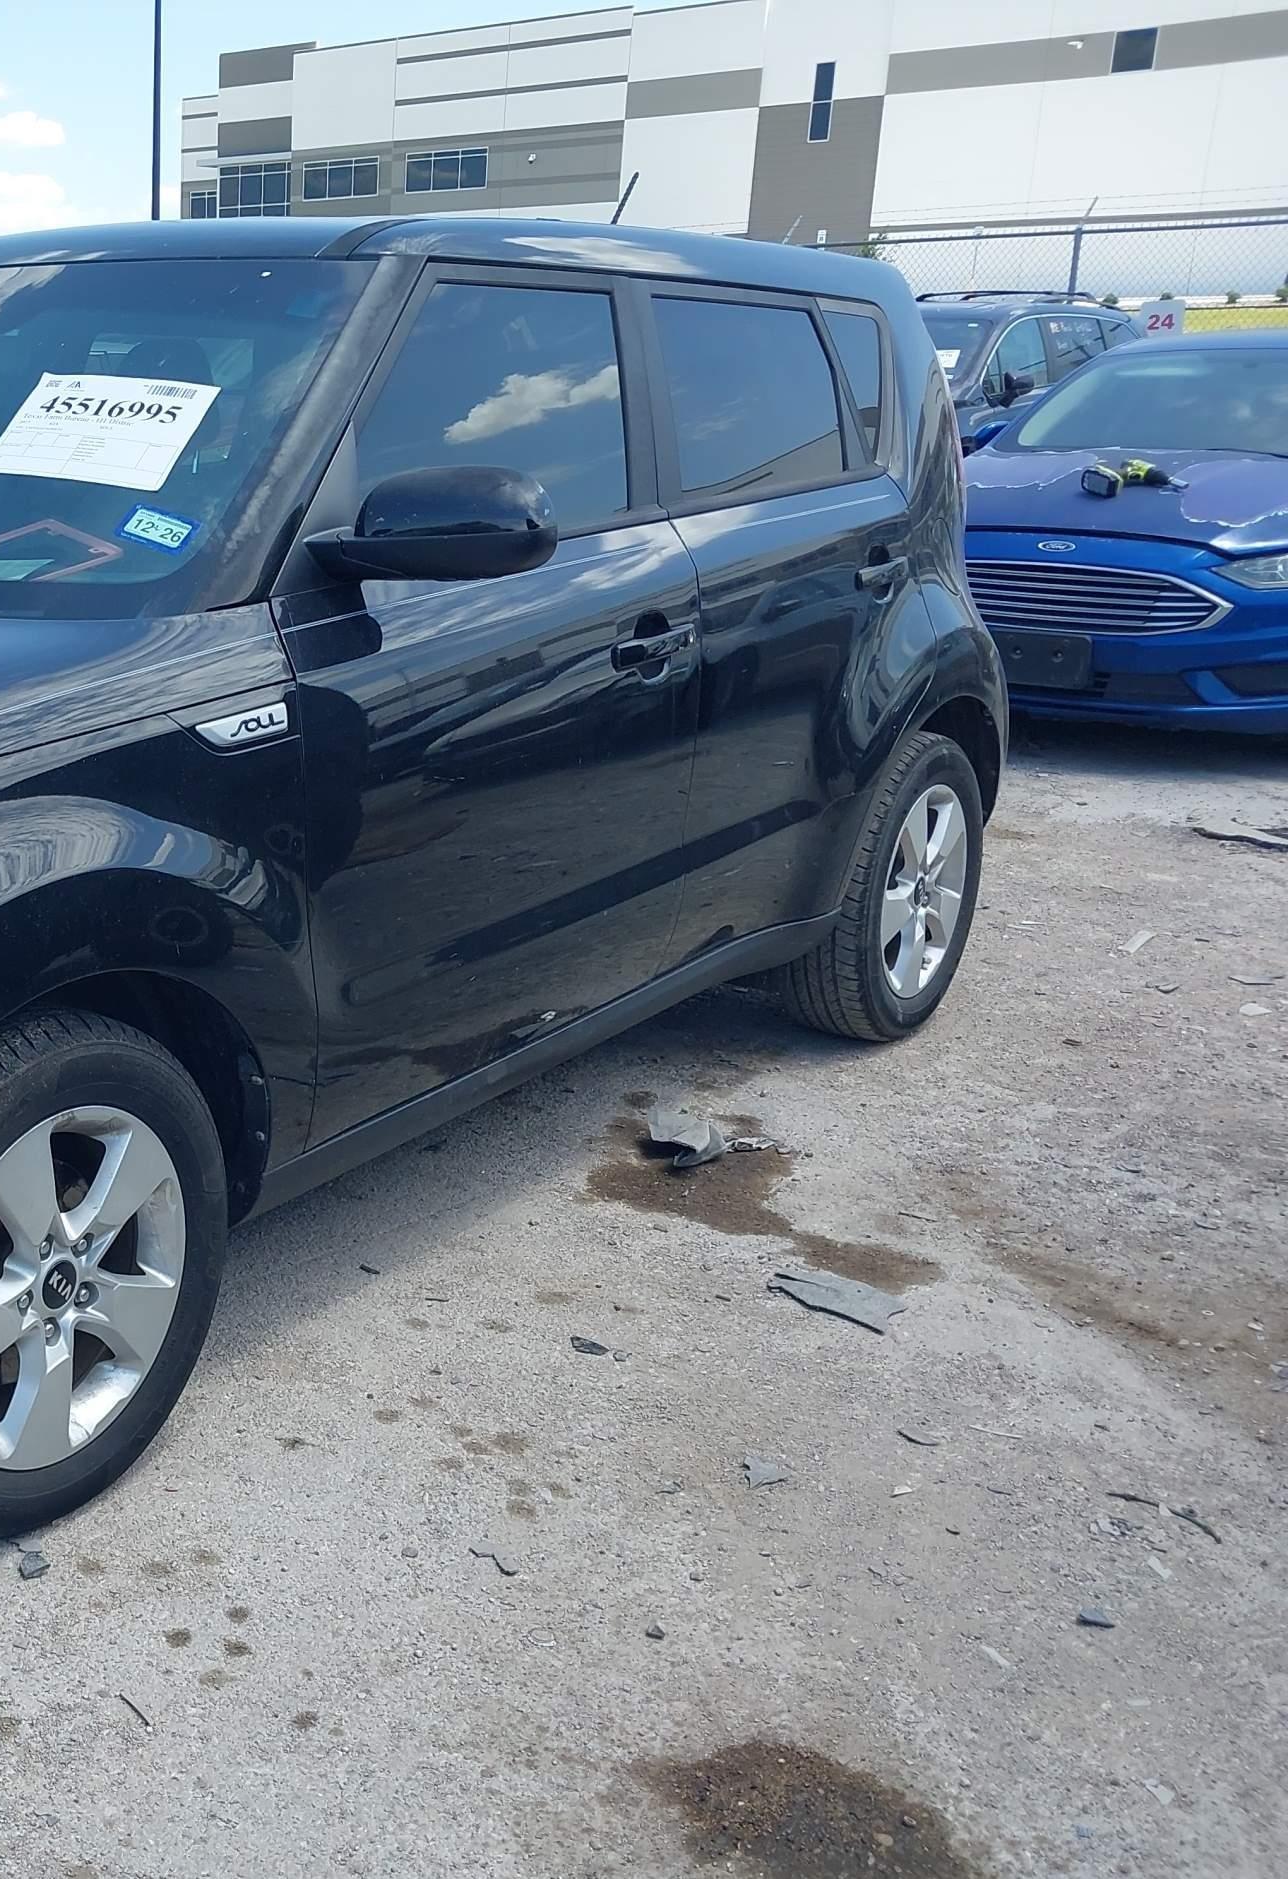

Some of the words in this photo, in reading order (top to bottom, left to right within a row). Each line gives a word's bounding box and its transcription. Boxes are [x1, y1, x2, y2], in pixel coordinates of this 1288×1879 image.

[1147, 313, 1175, 330] 24
[39, 395, 183, 424] 45516995
[133, 518, 155, 534] 12
[158, 527, 184, 543] 26
[230, 712, 285, 738] SOUL
[48, 1270, 72, 1301] KIA
